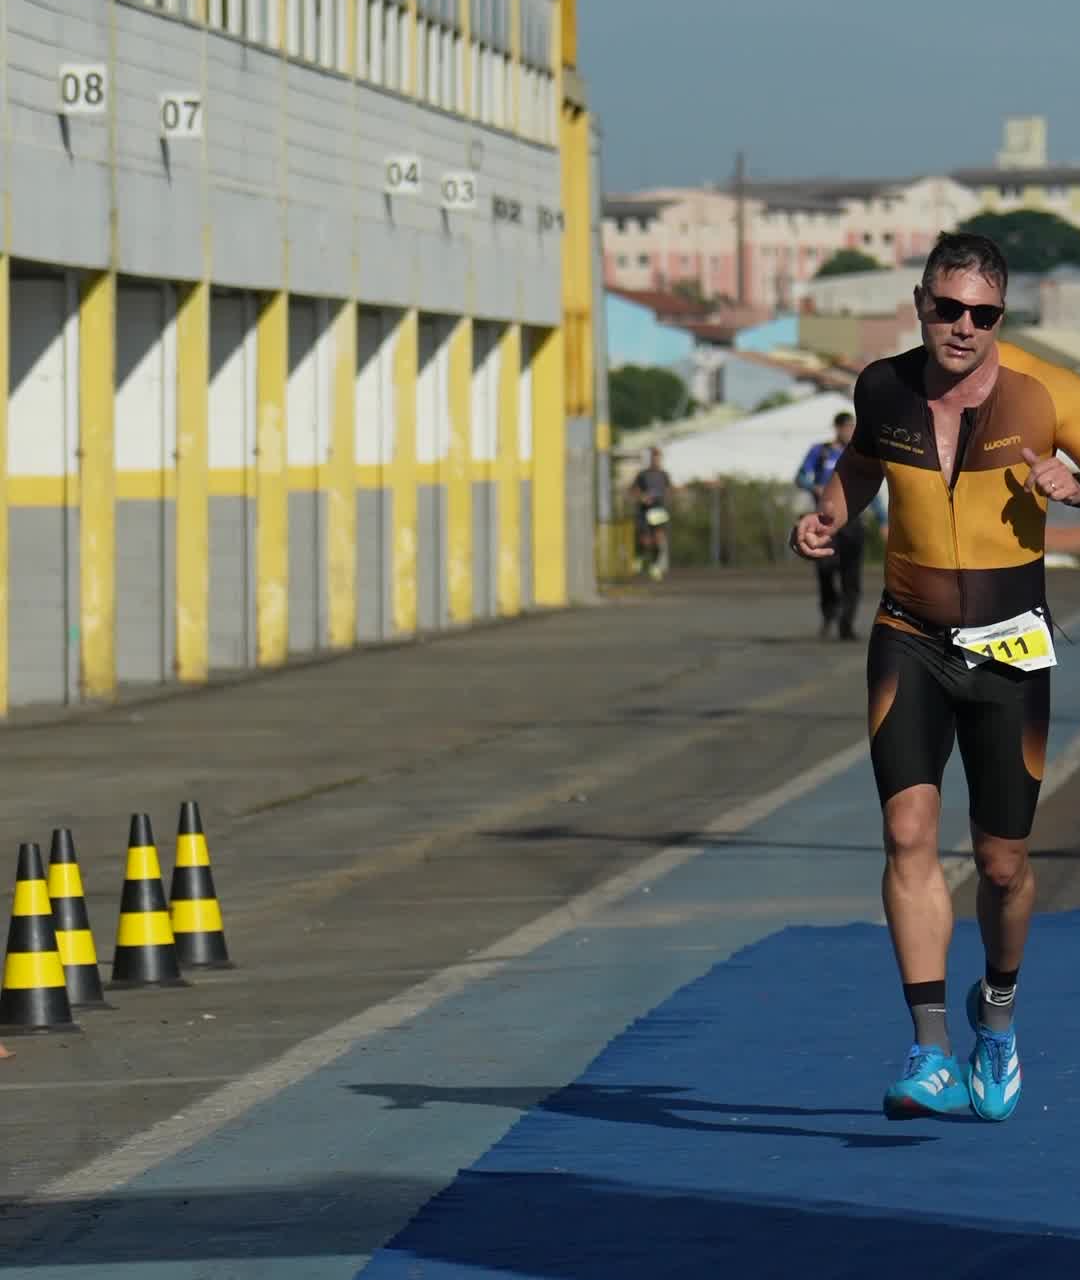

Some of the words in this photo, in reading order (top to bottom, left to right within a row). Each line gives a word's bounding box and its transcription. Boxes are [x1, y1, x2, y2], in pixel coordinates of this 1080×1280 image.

[61, 72, 104, 105] 08
[162, 99, 201, 129] 07
[386, 161, 419, 186] 04
[441, 179, 475, 202] 03
